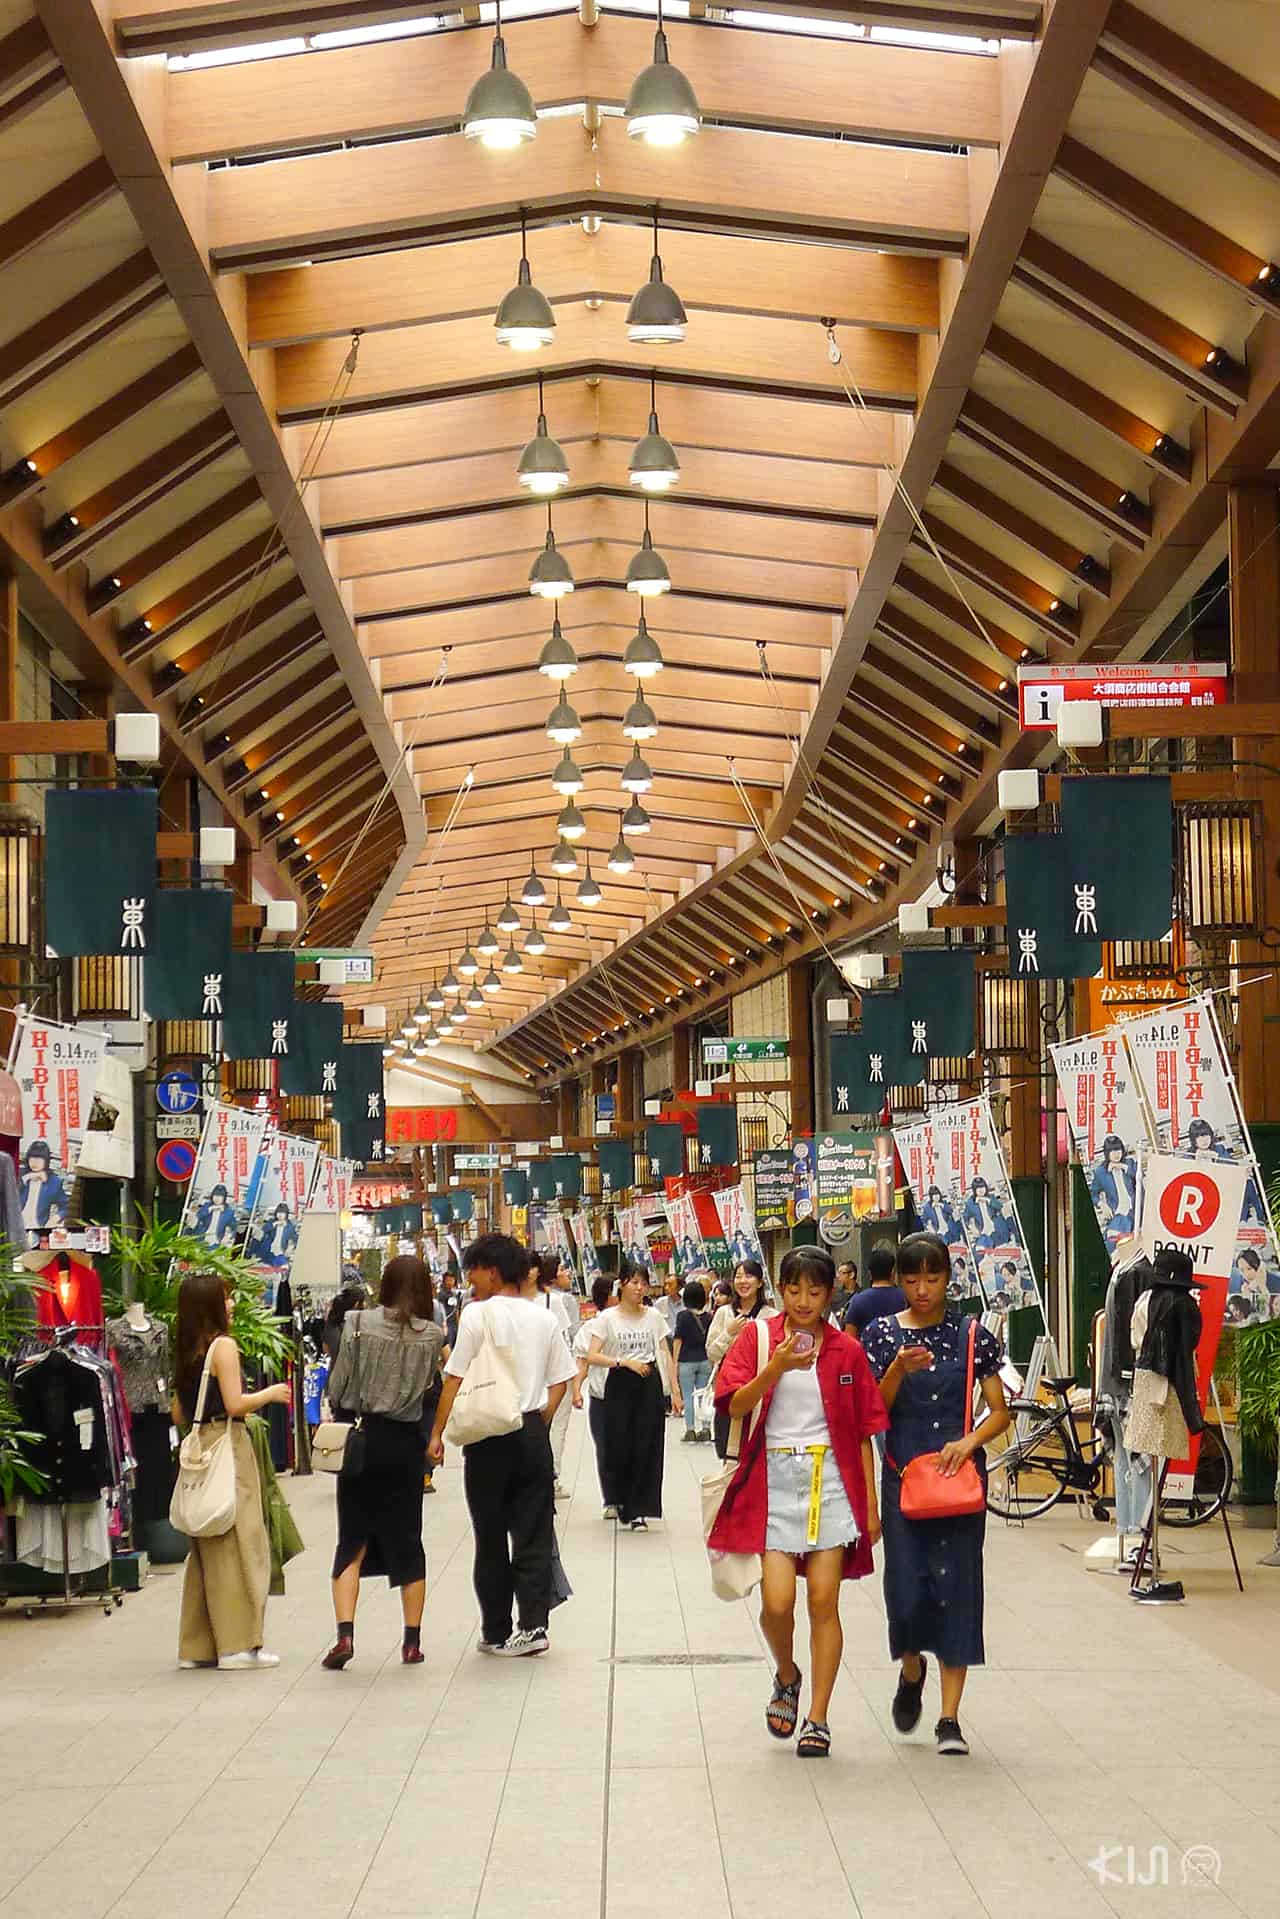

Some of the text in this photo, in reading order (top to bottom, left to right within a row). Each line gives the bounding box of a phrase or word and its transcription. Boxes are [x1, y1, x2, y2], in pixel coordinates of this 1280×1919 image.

[1095, 666, 1153, 677] Welcome
[1100, 982, 1177, 1002] かぶちゃん
[53, 1042, 82, 1059] 9.14
[31, 1030, 52, 1138] HIBIKI
[217, 1112, 229, 1183] HIBIKI
